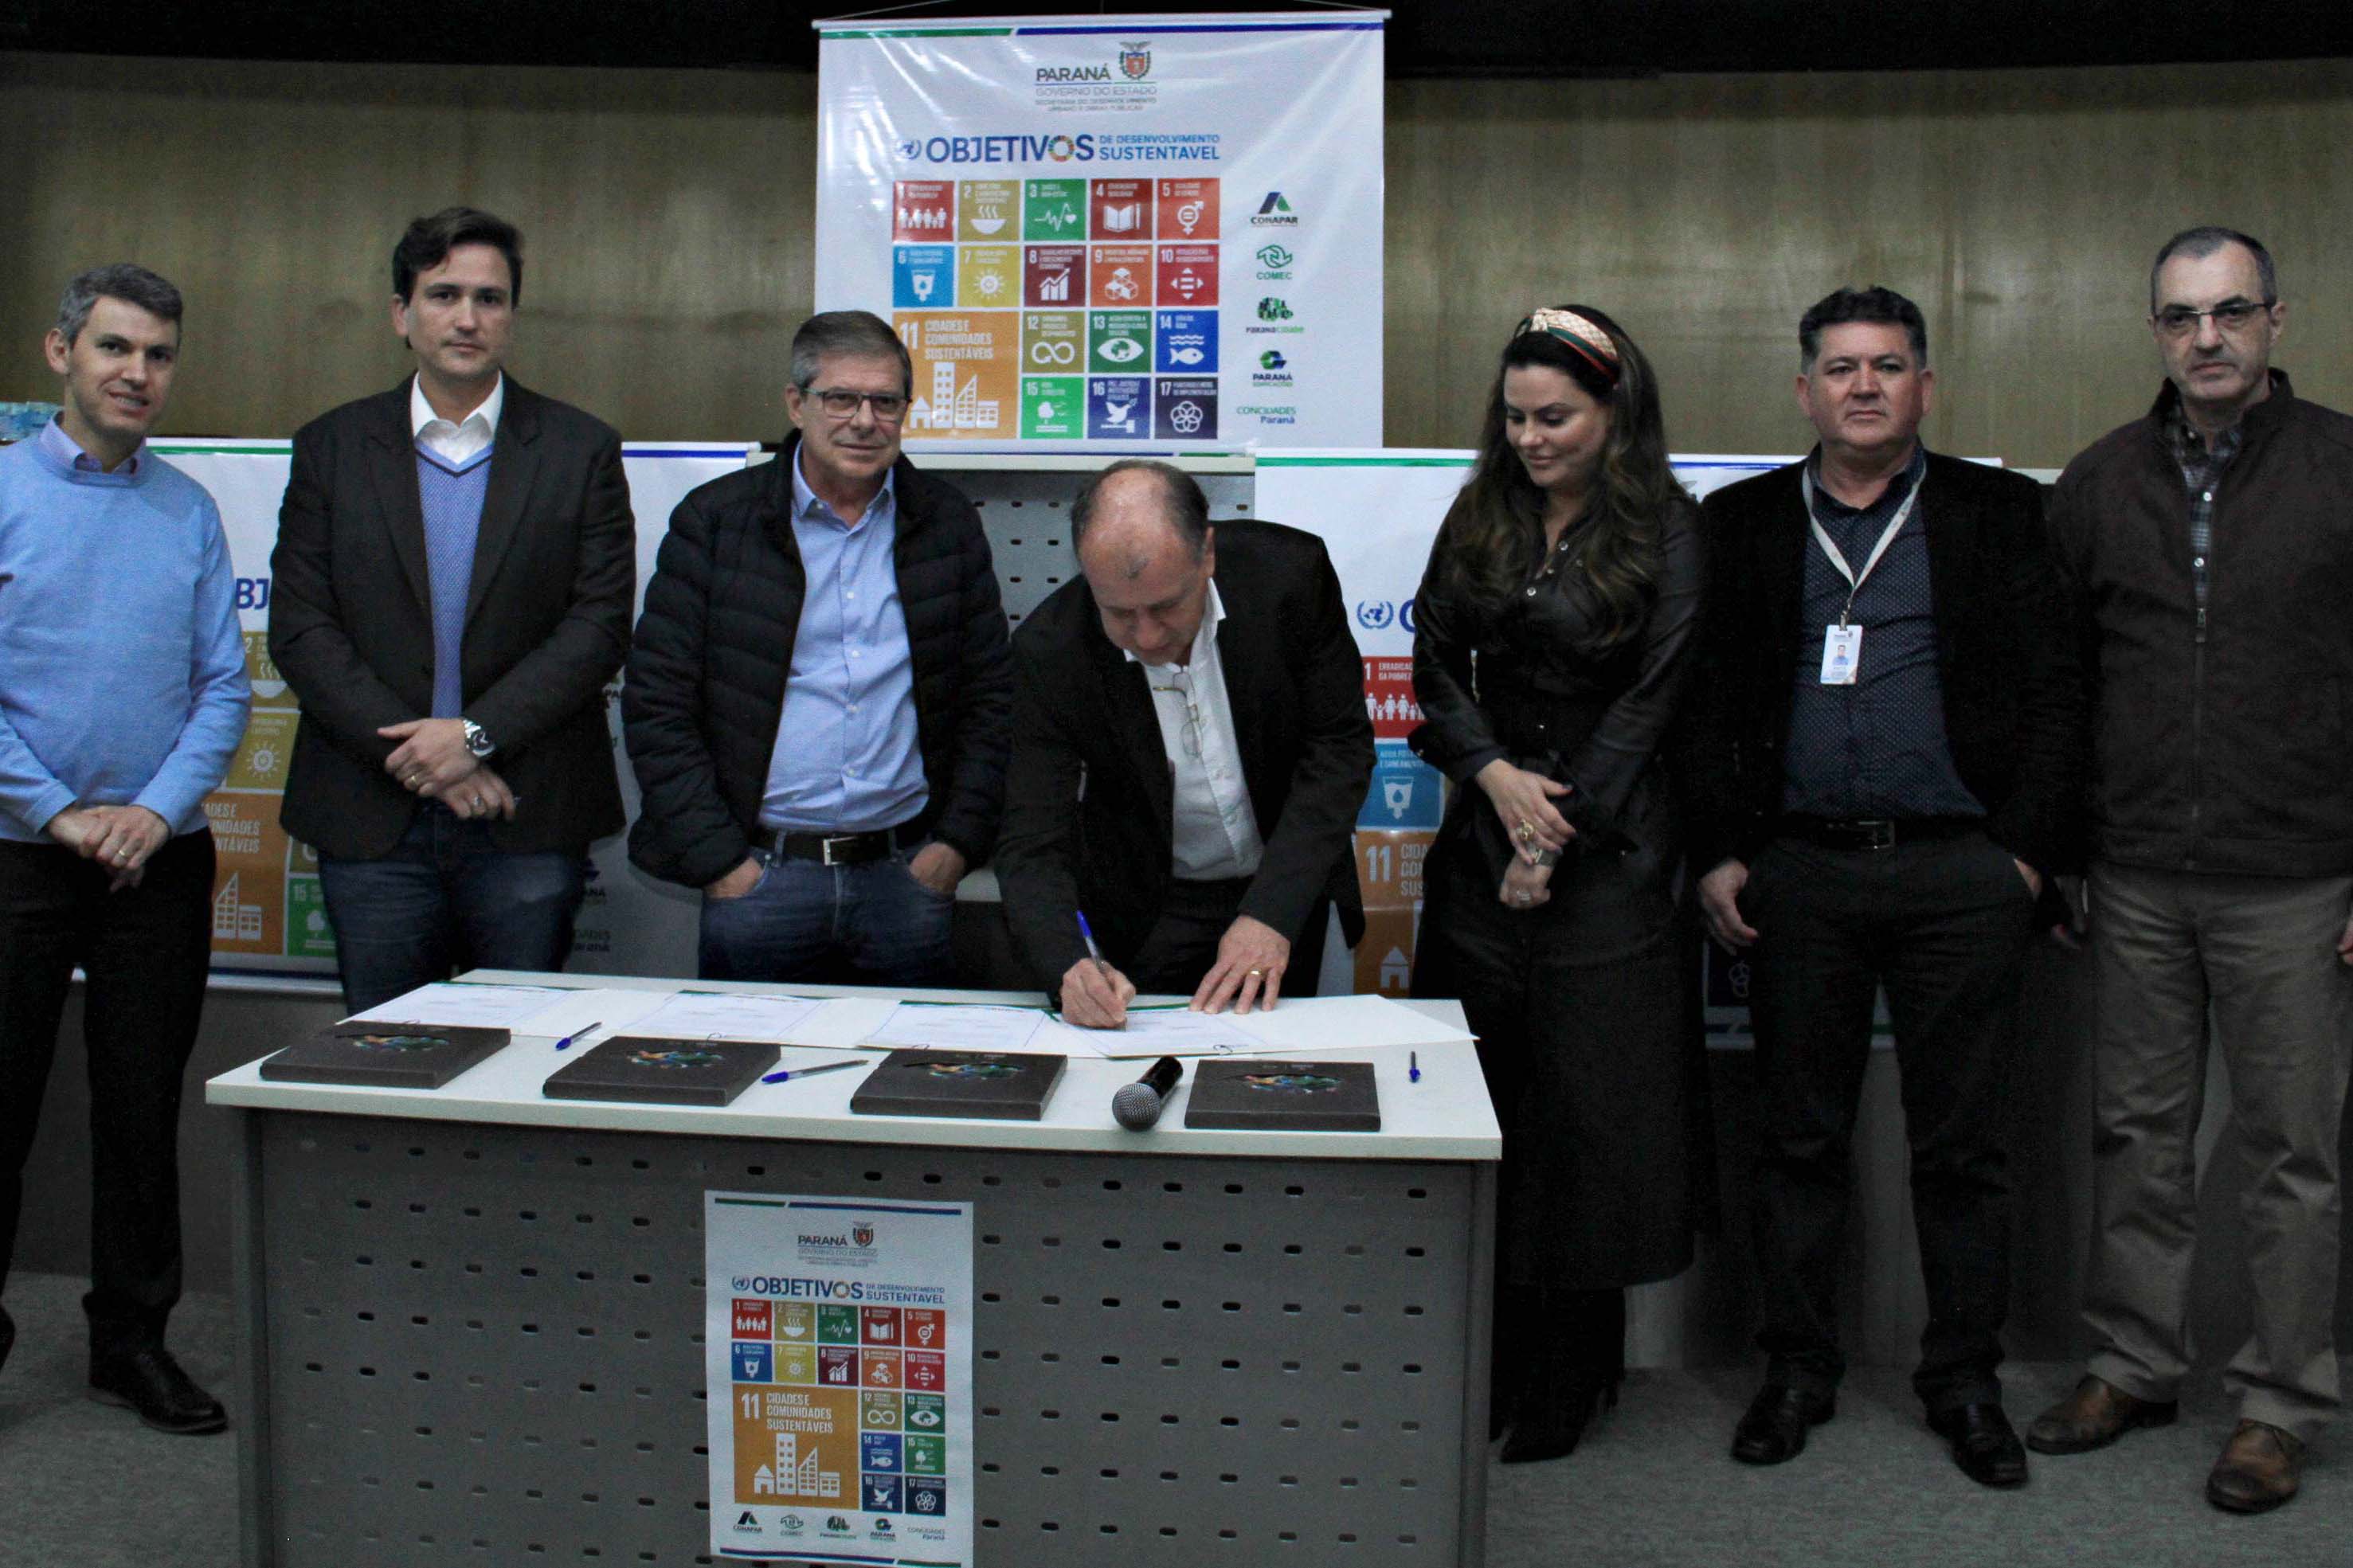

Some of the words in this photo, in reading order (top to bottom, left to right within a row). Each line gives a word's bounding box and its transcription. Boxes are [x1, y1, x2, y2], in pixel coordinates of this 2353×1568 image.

[1036, 63, 1111, 81] PARANÁ
[1036, 87, 1090, 96] GOVERNO
[1094, 87, 1110, 96] DO
[1113, 86, 1157, 96] ESTADO
[1099, 135, 1113, 144] DE
[1116, 134, 1220, 144] DESENVOLVIMENTO
[926, 134, 1094, 163] OBJETIVOS
[964, 184, 972, 198] 2
[1095, 184, 1104, 197] 4
[1162, 184, 1170, 197] 5
[964, 250, 972, 264] 7
[1029, 250, 1037, 264] 8
[1095, 249, 1103, 264] 9
[1161, 248, 1173, 263] 10
[1256, 272, 1293, 280] COMEC
[925, 319, 962, 332] CIDADES
[1027, 315, 1039, 330] 12
[1093, 315, 1105, 330] 13
[1160, 315, 1172, 329] 14
[899, 321, 918, 351] 11
[925, 332, 993, 345] COMUNIDADES
[1026, 382, 1038, 396] 15
[1093, 381, 1105, 396] 16
[1161, 381, 1171, 396] 17
[1260, 416, 1295, 424] Paraná
[1364, 662, 1372, 681] 1
[1366, 845, 1392, 882] 11
[797, 1234, 848, 1246] PARANÁ
[752, 1276, 863, 1300] OBJETIVOS
[906, 1353, 916, 1363] 10
[766, 1393, 804, 1405] CIDADES
[805, 1394, 810, 1406] E
[864, 1393, 872, 1402] 12
[741, 1392, 760, 1420] 11
[766, 1405, 832, 1420] COMUNIDADES
[864, 1435, 871, 1445] 14
